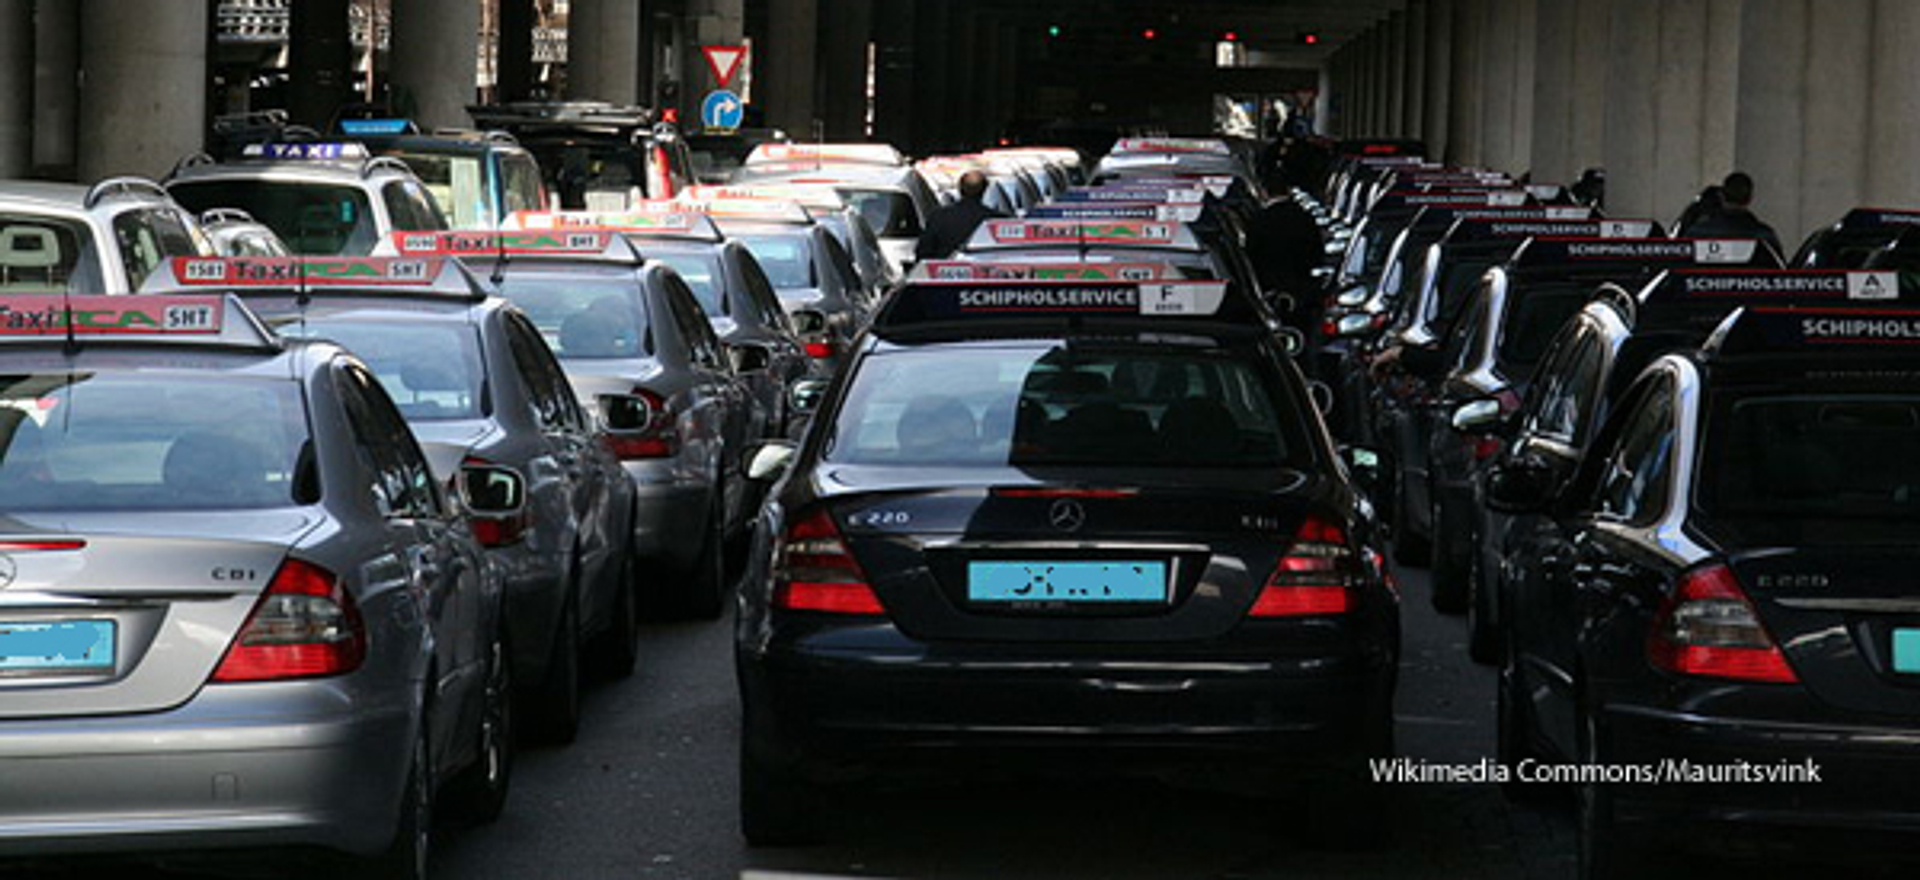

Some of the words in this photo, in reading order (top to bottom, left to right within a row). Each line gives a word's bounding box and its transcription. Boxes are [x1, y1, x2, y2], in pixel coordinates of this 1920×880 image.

[272, 145, 336, 157] TAXI
[1566, 242, 1692, 255] SCHIPHOLSERVICE
[232, 261, 294, 279] Taxi
[1684, 277, 1844, 291] SCHIPHOLSERVICE
[958, 289, 1138, 306] SCHIPHOLSERVICE
[1161, 285, 1174, 301] F
[169, 309, 209, 327] SHT
[211, 566, 256, 581] CDI
